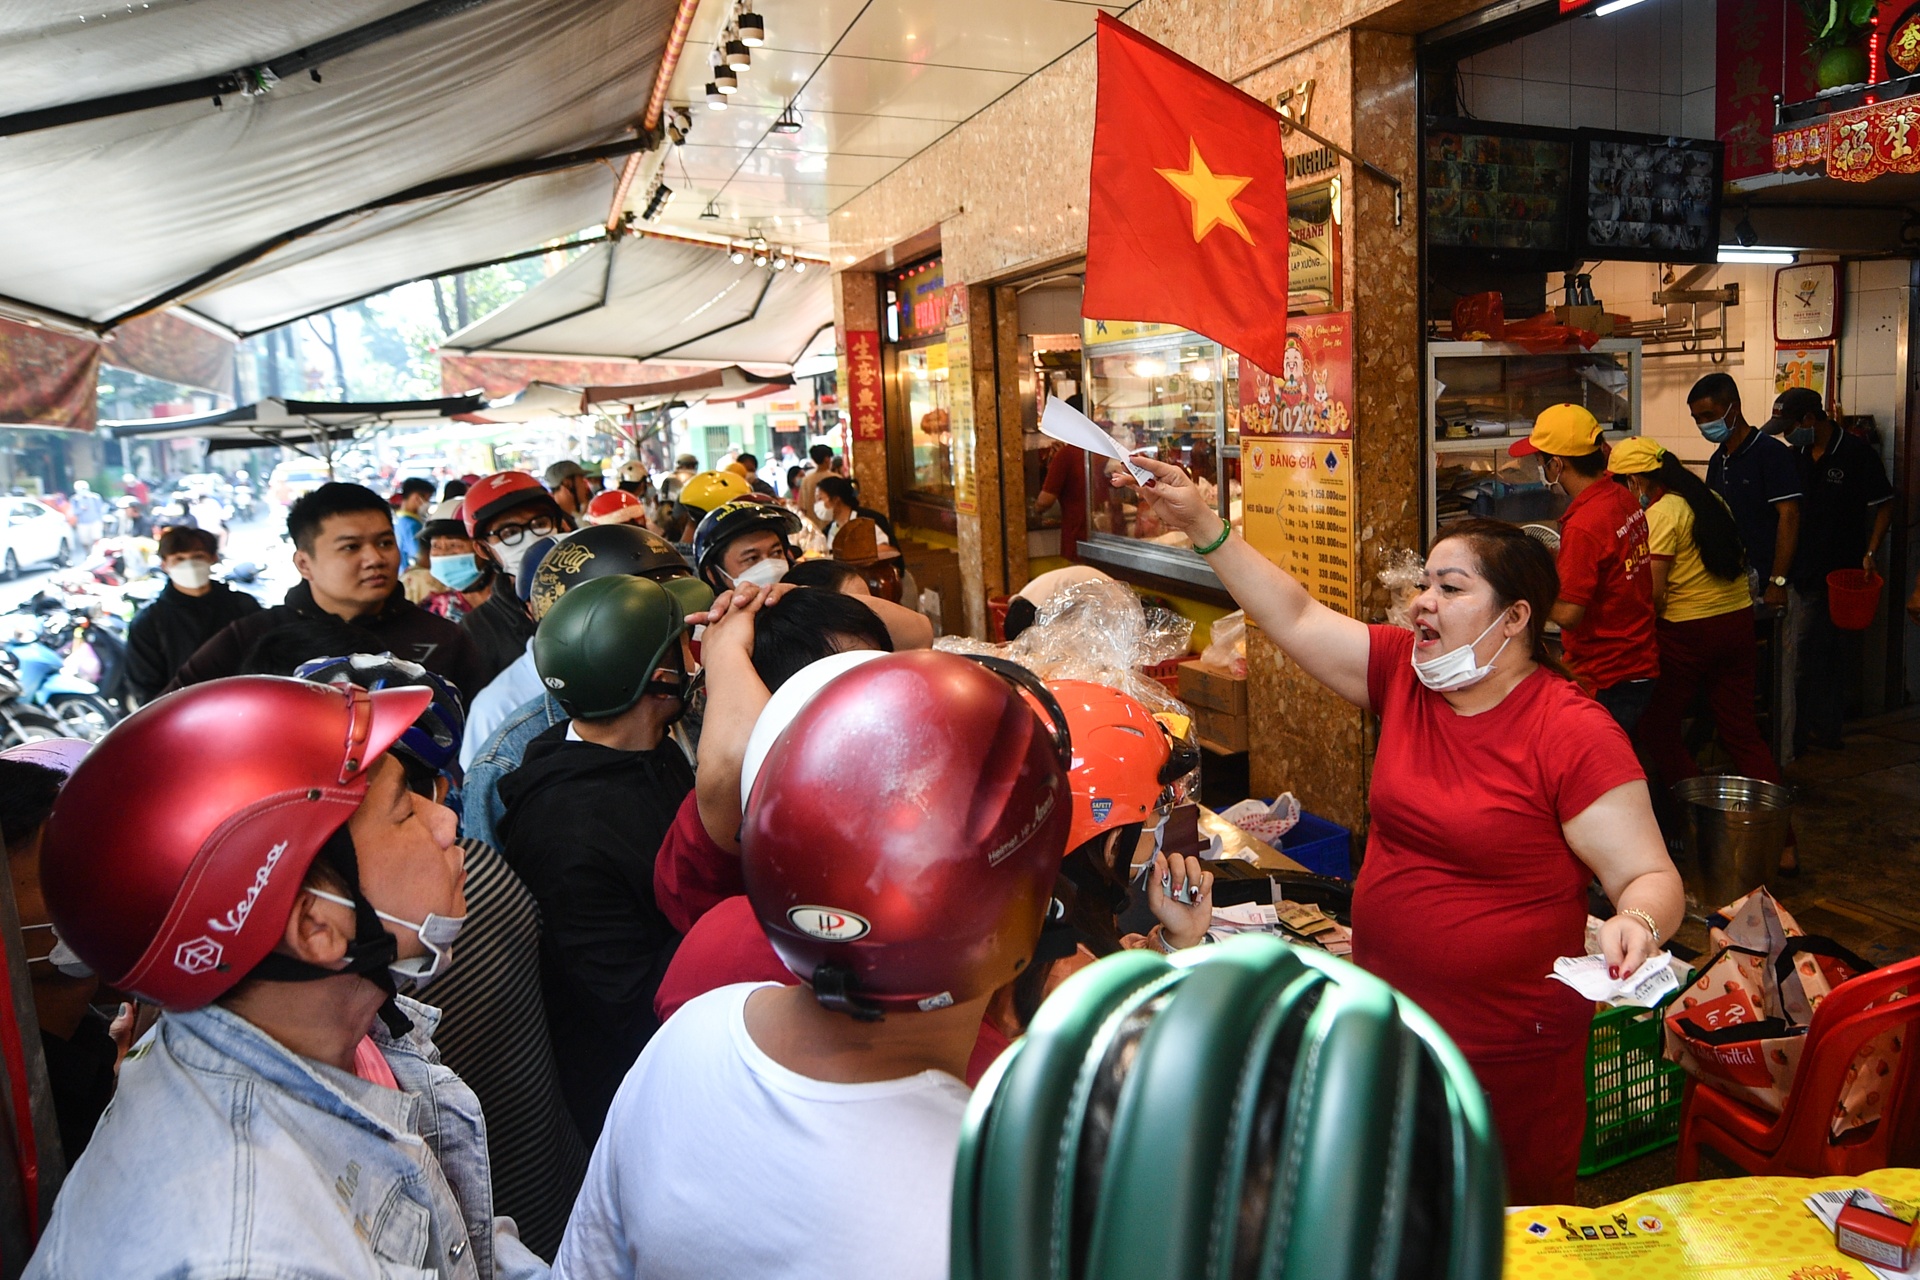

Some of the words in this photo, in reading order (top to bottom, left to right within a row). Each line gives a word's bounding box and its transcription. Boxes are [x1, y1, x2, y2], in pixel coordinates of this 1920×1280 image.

[1784, 361, 1812, 390] 31
[1270, 405, 1314, 434] 2023
[1270, 448, 1296, 468] BẢNG
[1299, 452, 1317, 469] GIÁ
[988, 834, 1019, 863] Helmet
[208, 840, 288, 936] Vespa
[1714, 1046, 1756, 1066] frutta!
